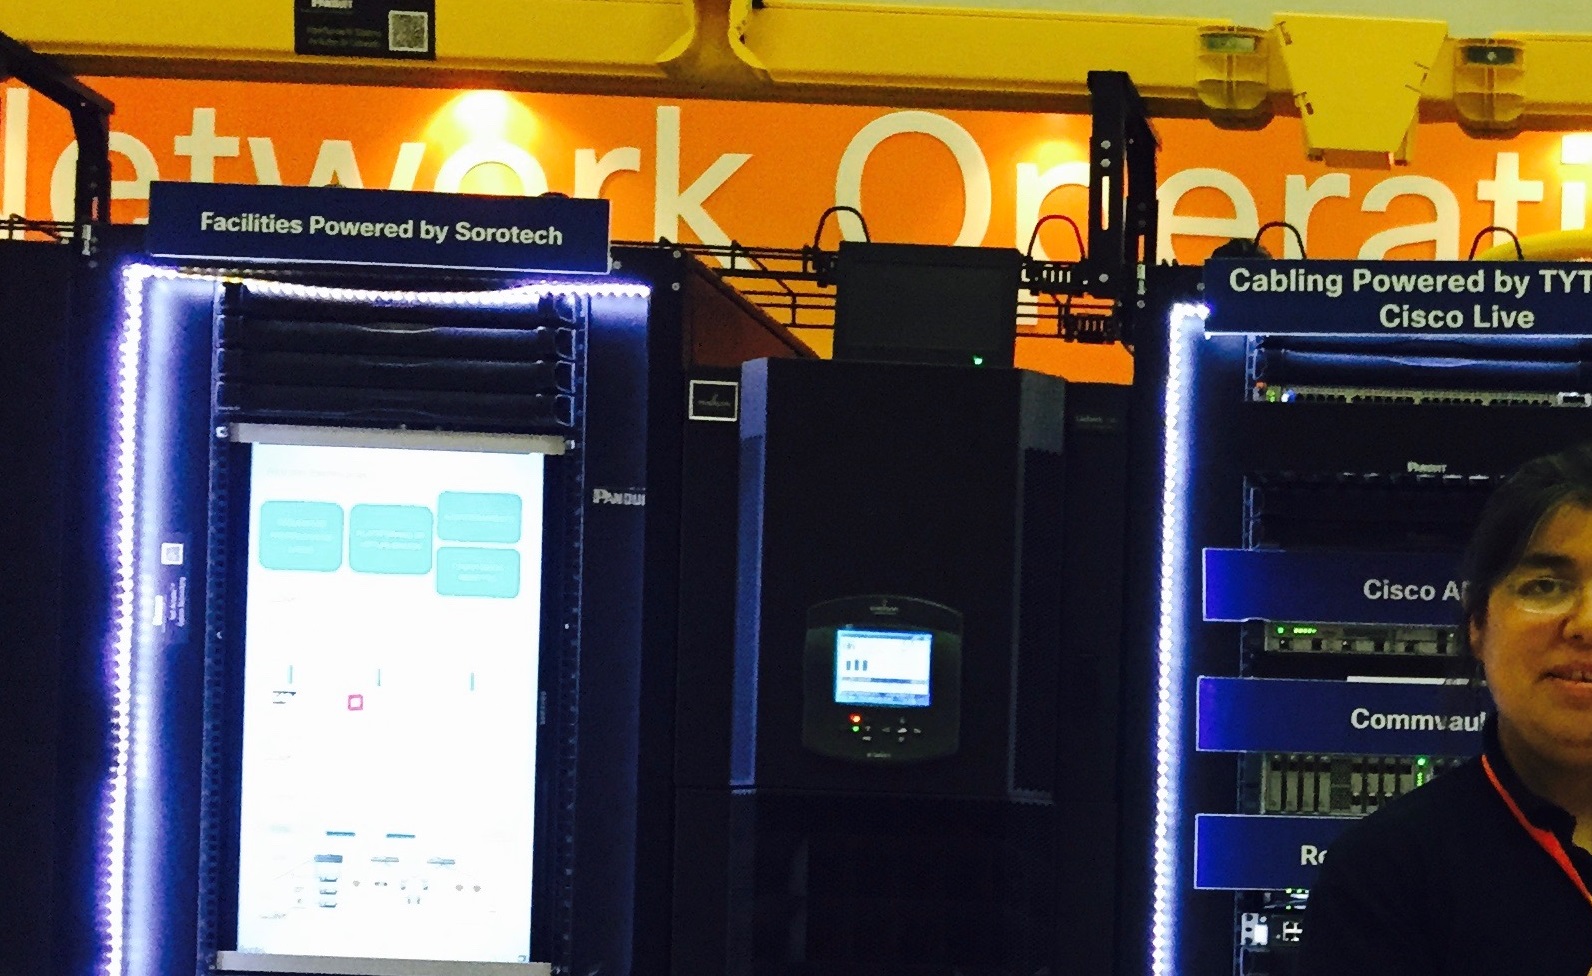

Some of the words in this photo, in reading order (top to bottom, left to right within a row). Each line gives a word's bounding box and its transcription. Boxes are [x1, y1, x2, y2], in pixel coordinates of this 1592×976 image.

[0, 86, 757, 270] etwork
[200, 211, 304, 234] Facilities
[309, 215, 414, 239] Powered
[419, 219, 449, 244] by
[454, 221, 563, 246] Sorotech
[1229, 267, 1343, 298] Cabling
[1353, 268, 1485, 293] Powered
[1494, 269, 1531, 299] by
[1379, 303, 1464, 330] Cisco
[1473, 303, 1535, 330] Live
[1363, 578, 1436, 601] Cisco
